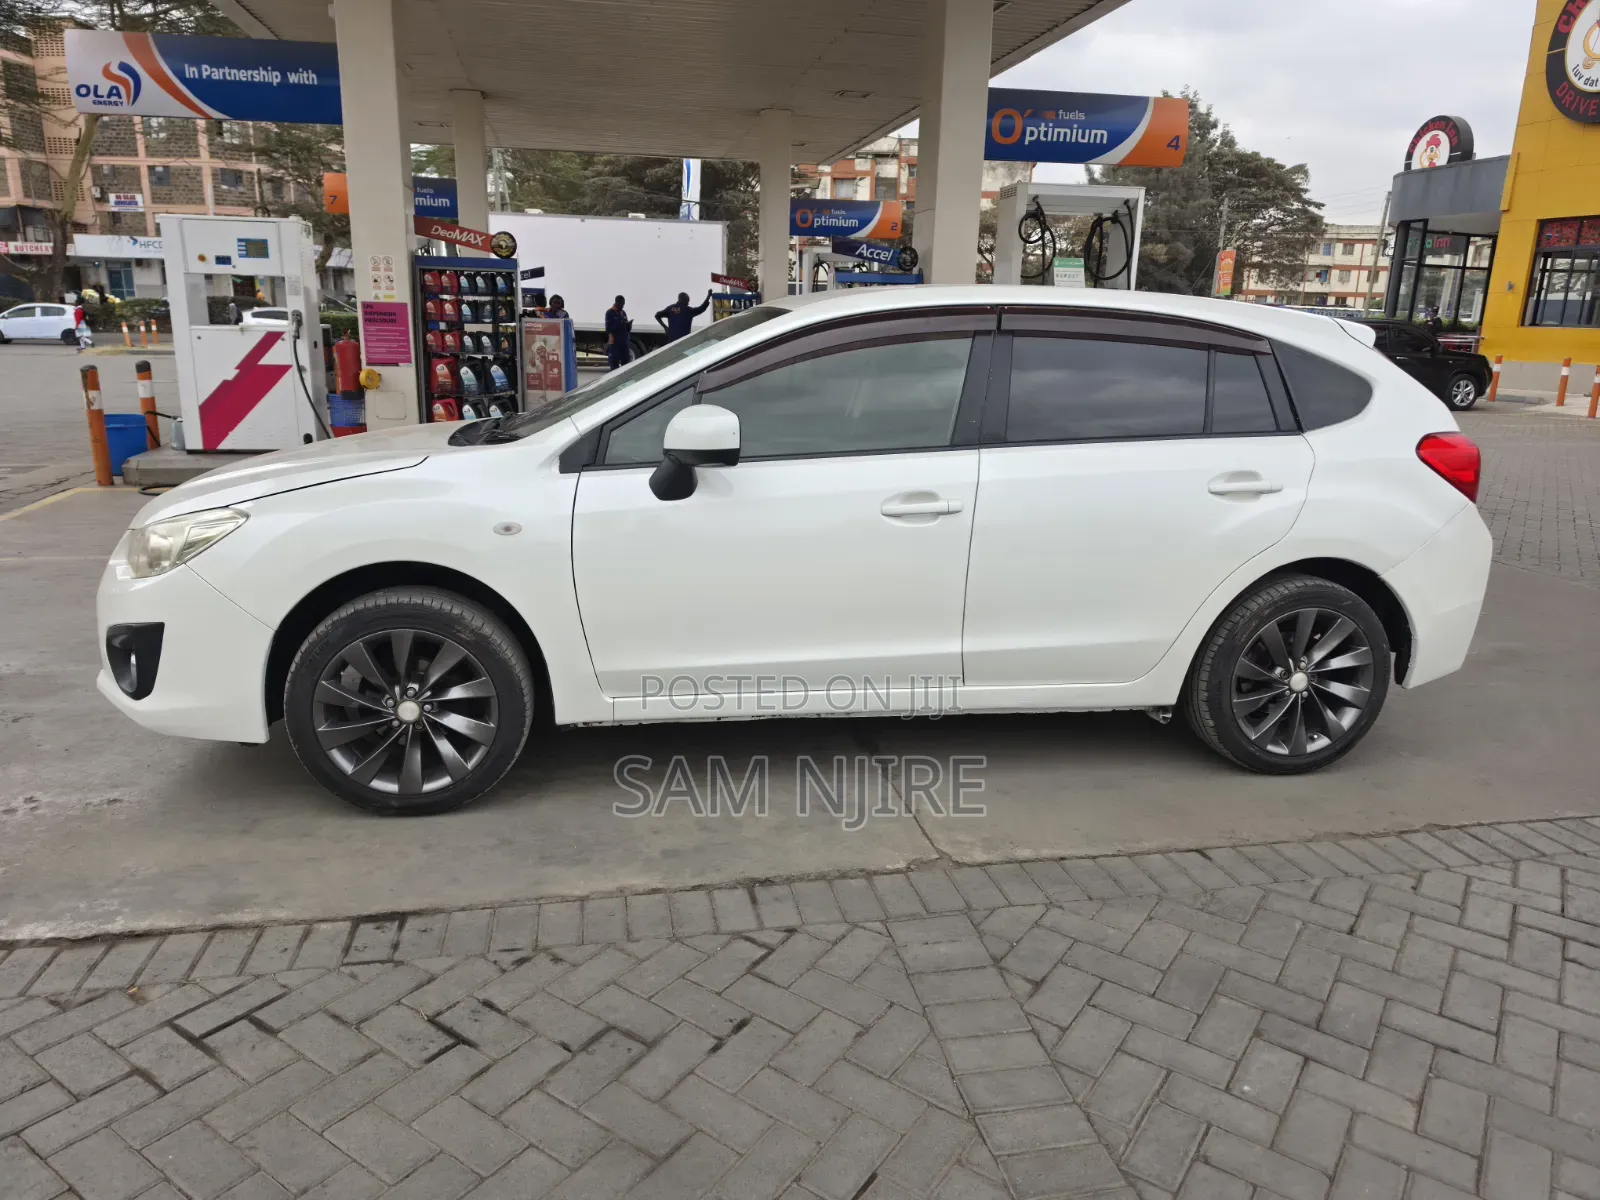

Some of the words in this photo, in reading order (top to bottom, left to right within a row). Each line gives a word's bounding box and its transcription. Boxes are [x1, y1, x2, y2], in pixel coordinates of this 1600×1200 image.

[184, 64, 199, 79] In
[202, 64, 281, 86] Partnership
[287, 68, 318, 85] with
[1572, 64, 1584, 81] luv
[1583, 76, 1599, 87] dat
[75, 83, 123, 99] OLA
[1555, 81, 1598, 116] DRIVE
[1058, 109, 1086, 120] fuels
[1166, 135, 1181, 151] 4
[328, 195, 338, 206] 7
[890, 222, 899, 231] 2
[430, 225, 486, 246] DeoMAX
[855, 244, 894, 261] Accel
